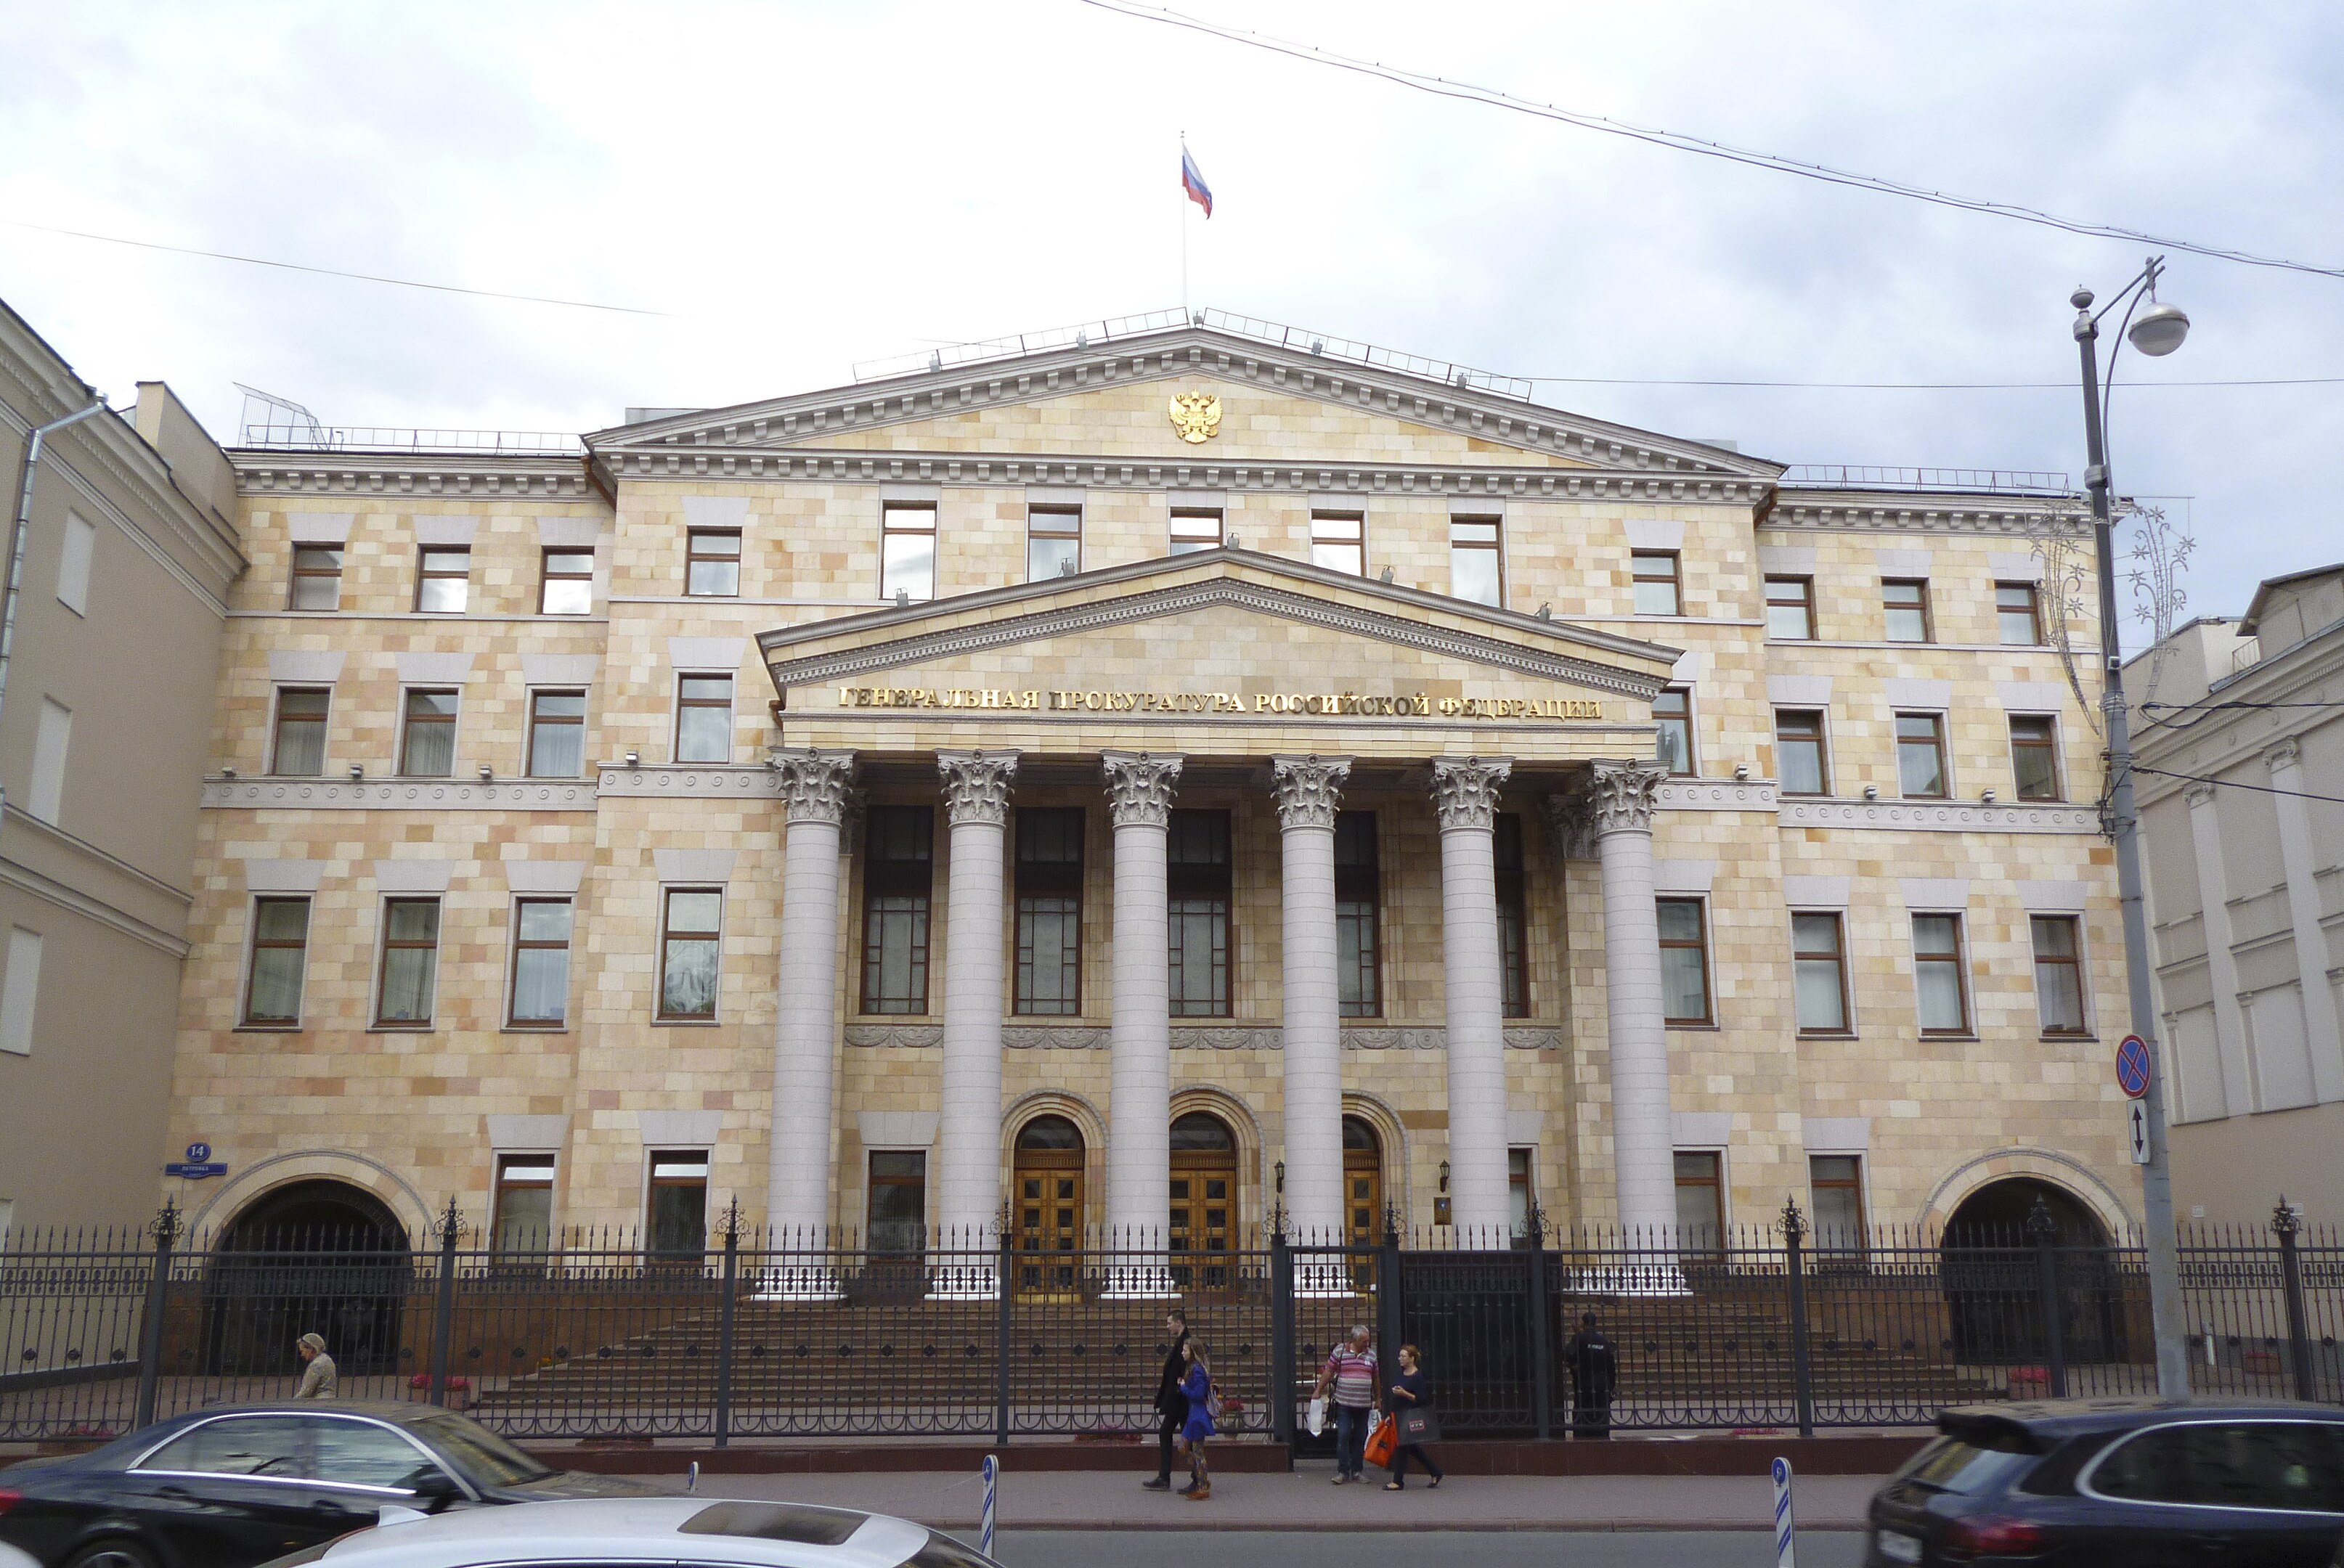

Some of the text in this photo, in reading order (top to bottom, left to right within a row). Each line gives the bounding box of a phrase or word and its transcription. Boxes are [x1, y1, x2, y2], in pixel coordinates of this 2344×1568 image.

[838, 686, 1602, 722] ГЕНЕРАЛЬНАЯ ПРОКУРАТУРА РОССИЙСКОЙ ФЕДЕРАЦИИ
[191, 1146, 204, 1156] 14
